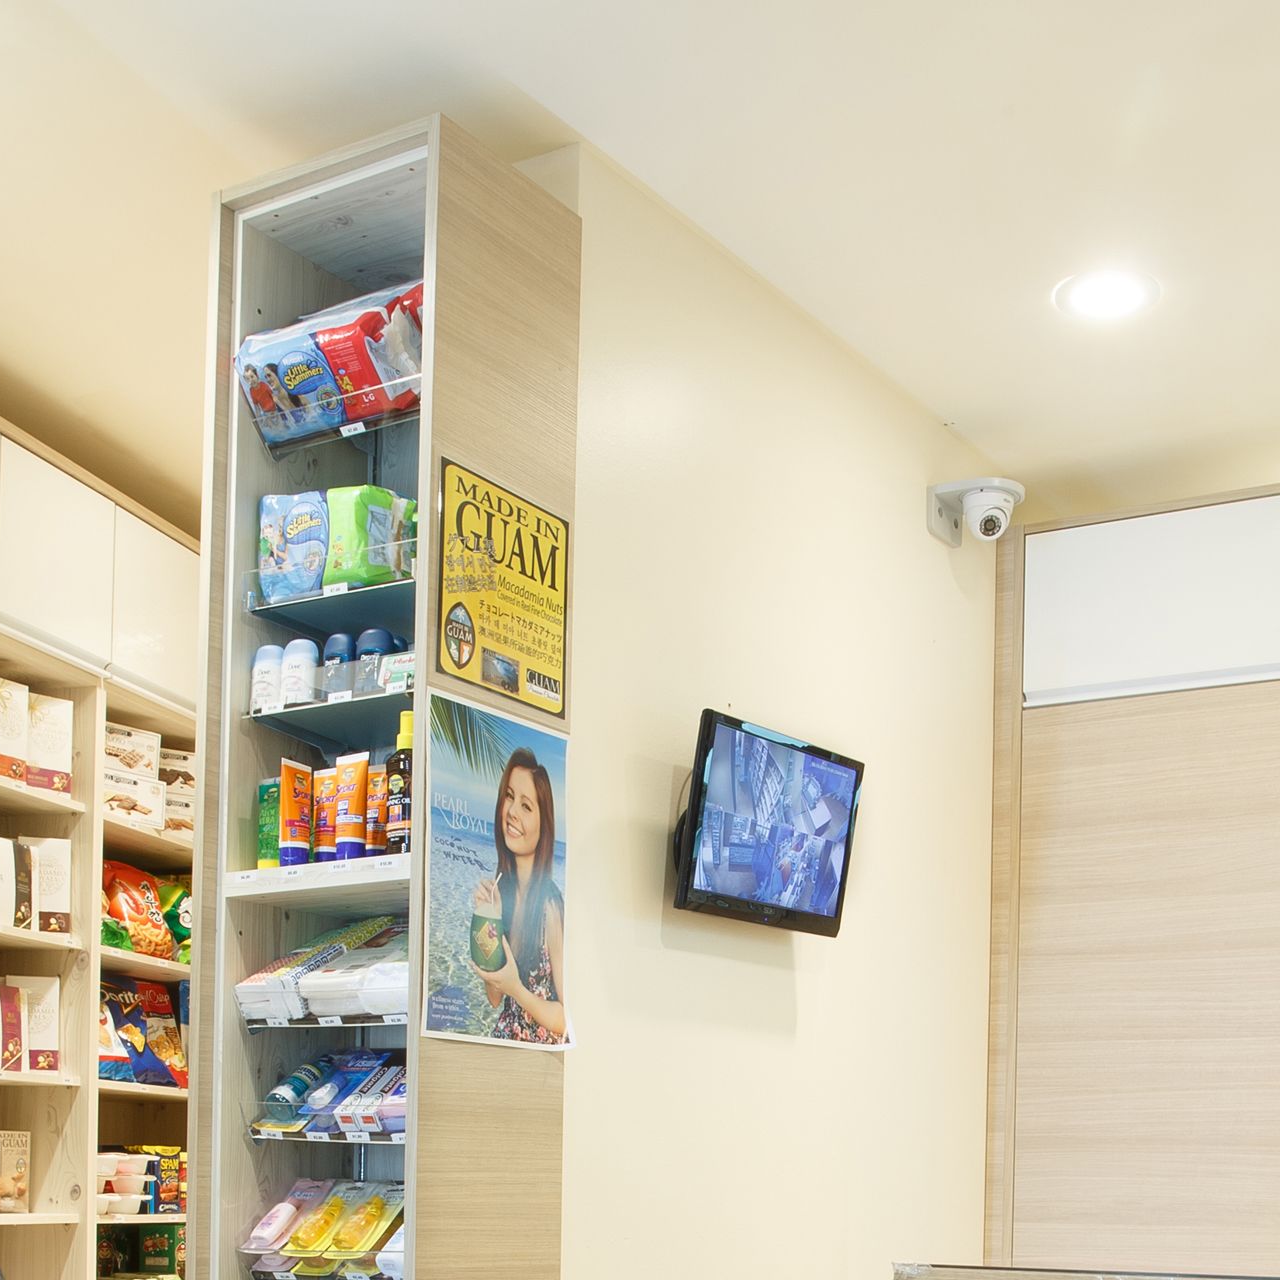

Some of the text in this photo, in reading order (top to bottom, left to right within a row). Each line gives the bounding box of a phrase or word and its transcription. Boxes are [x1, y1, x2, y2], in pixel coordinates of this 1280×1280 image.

[456, 475, 560, 543] MADE IN
[456, 500, 560, 592] GUAM
[497, 574, 545, 605] Macadamia
[546, 596, 563, 616] Nuts
[447, 629, 473, 645] GUAM
[527, 669, 560, 694] GUAM
[434, 792, 470, 816] PEARL
[452, 812, 490, 836] ROYAL
[159, 1158, 180, 1171] SPAM
